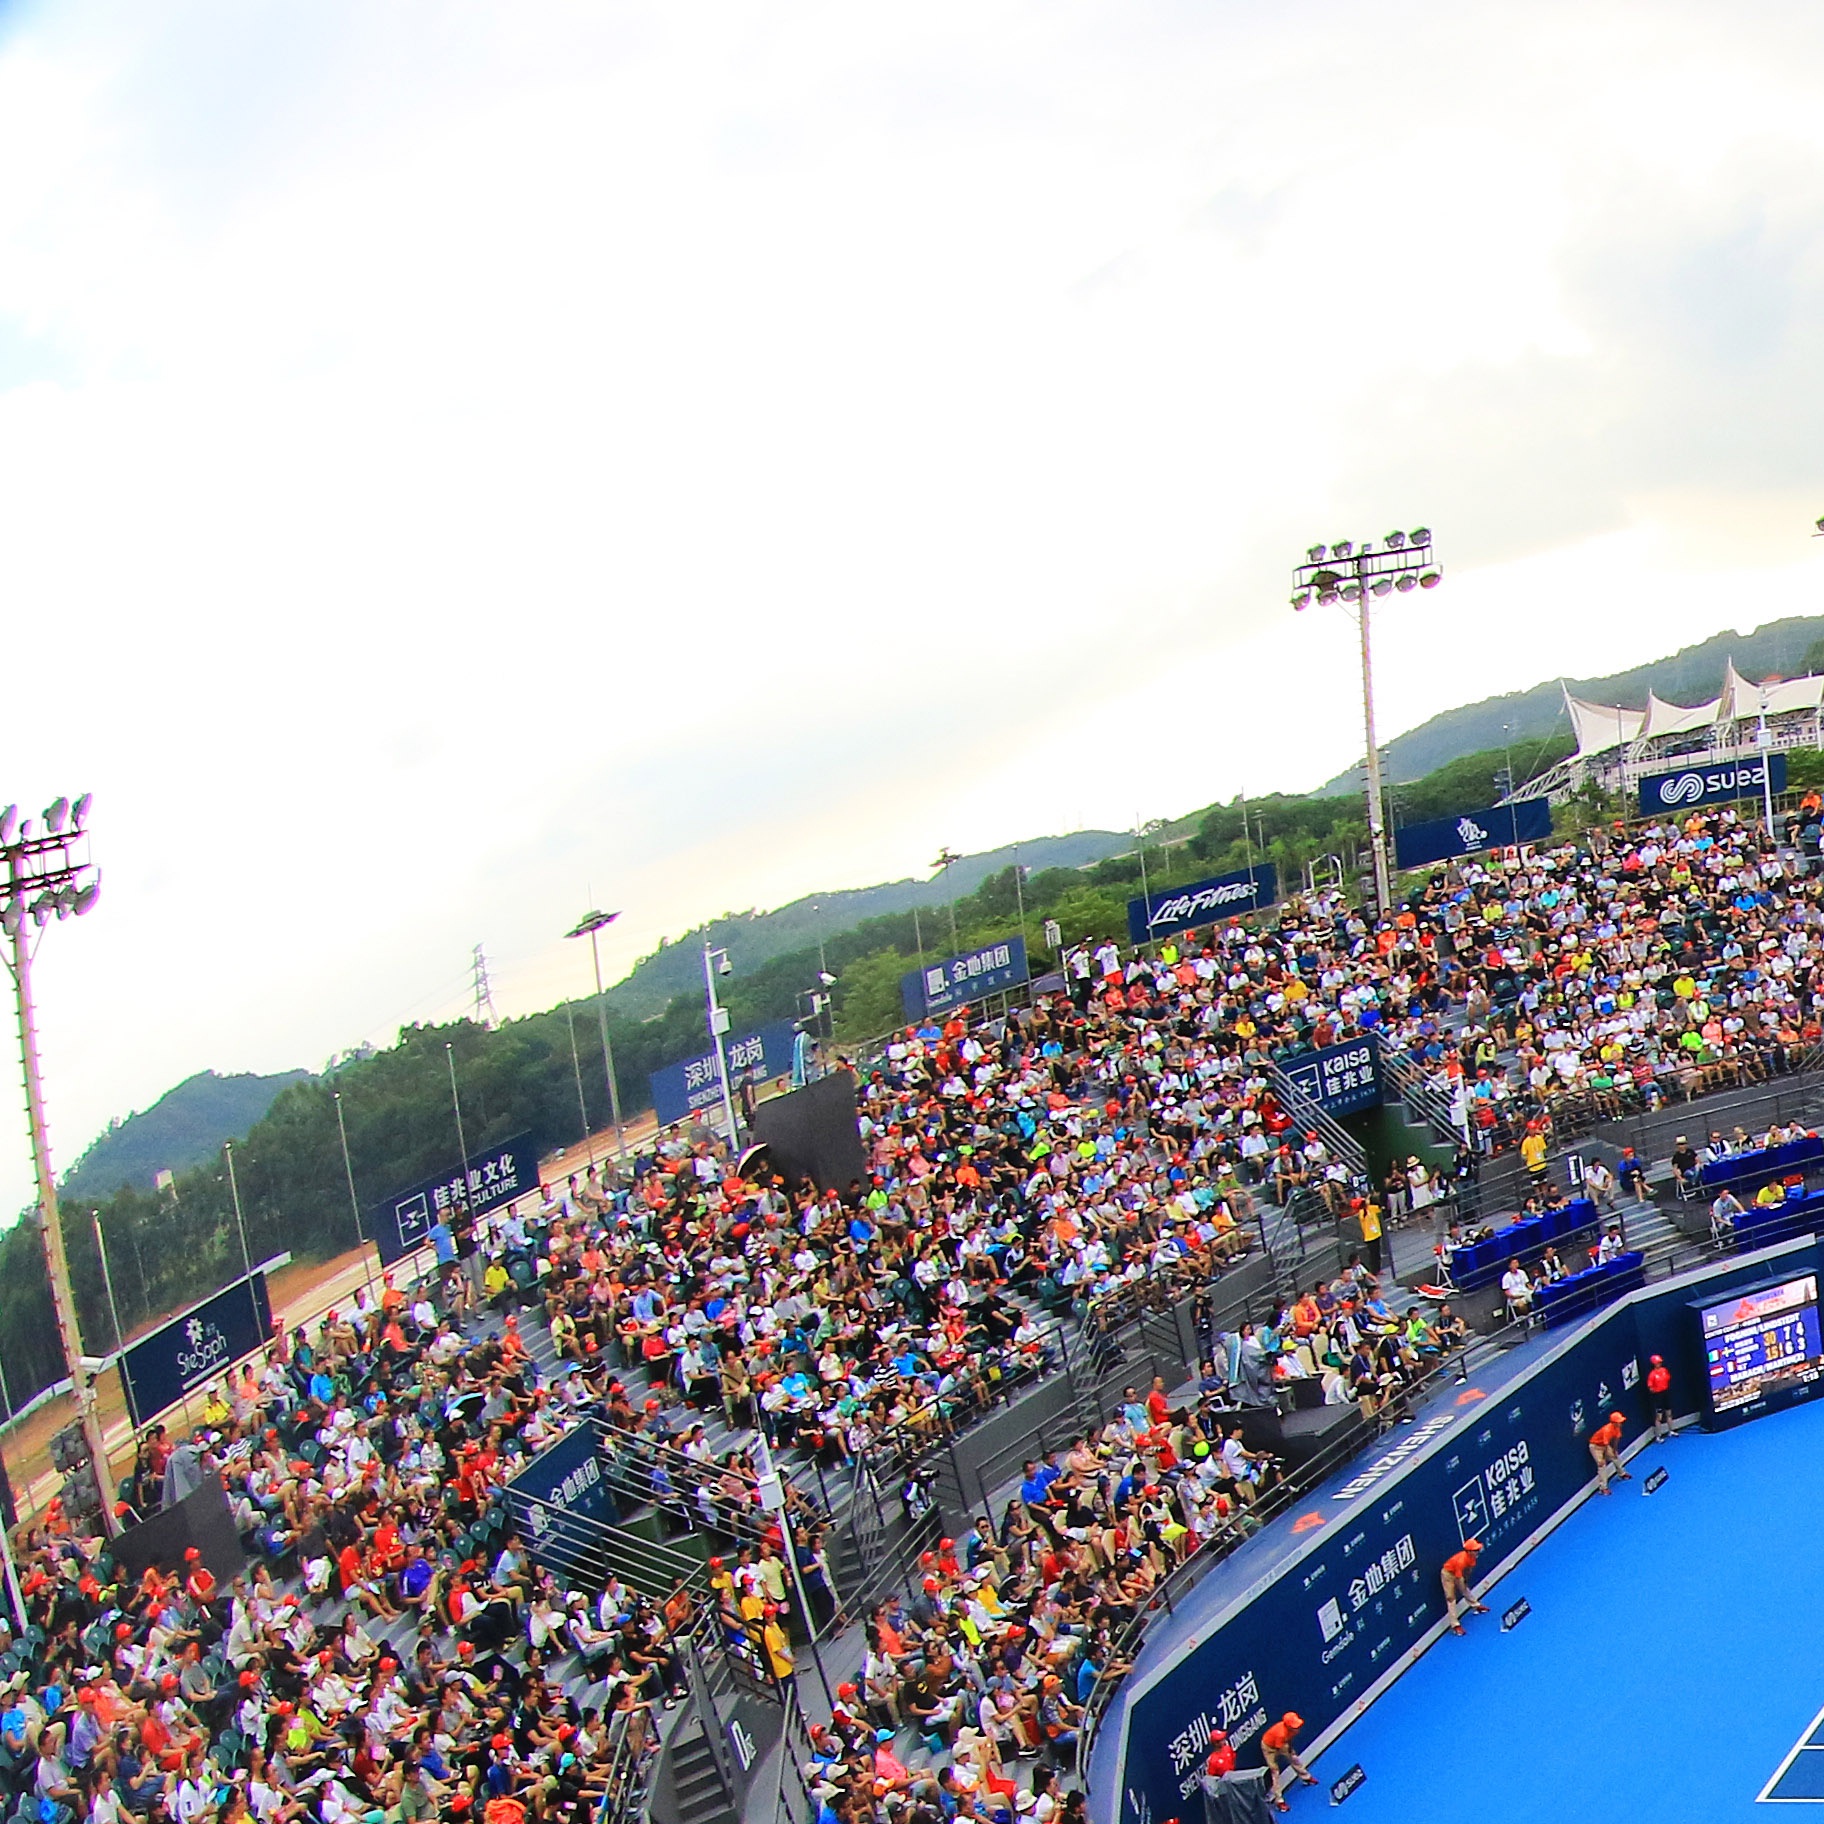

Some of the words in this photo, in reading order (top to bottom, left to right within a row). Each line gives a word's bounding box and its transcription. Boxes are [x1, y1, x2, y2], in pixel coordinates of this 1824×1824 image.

[1706, 766, 1766, 793] suez
[952, 944, 1011, 982] 金地集团
[1325, 1065, 1375, 1097] 佳兆业
[1330, 1415, 1455, 1500] SHENZHEN
[1490, 1465, 1536, 1519] 佳兆业
[1348, 1533, 1416, 1612] 金地集团
[1229, 1707, 1268, 1752] ONGGANG
